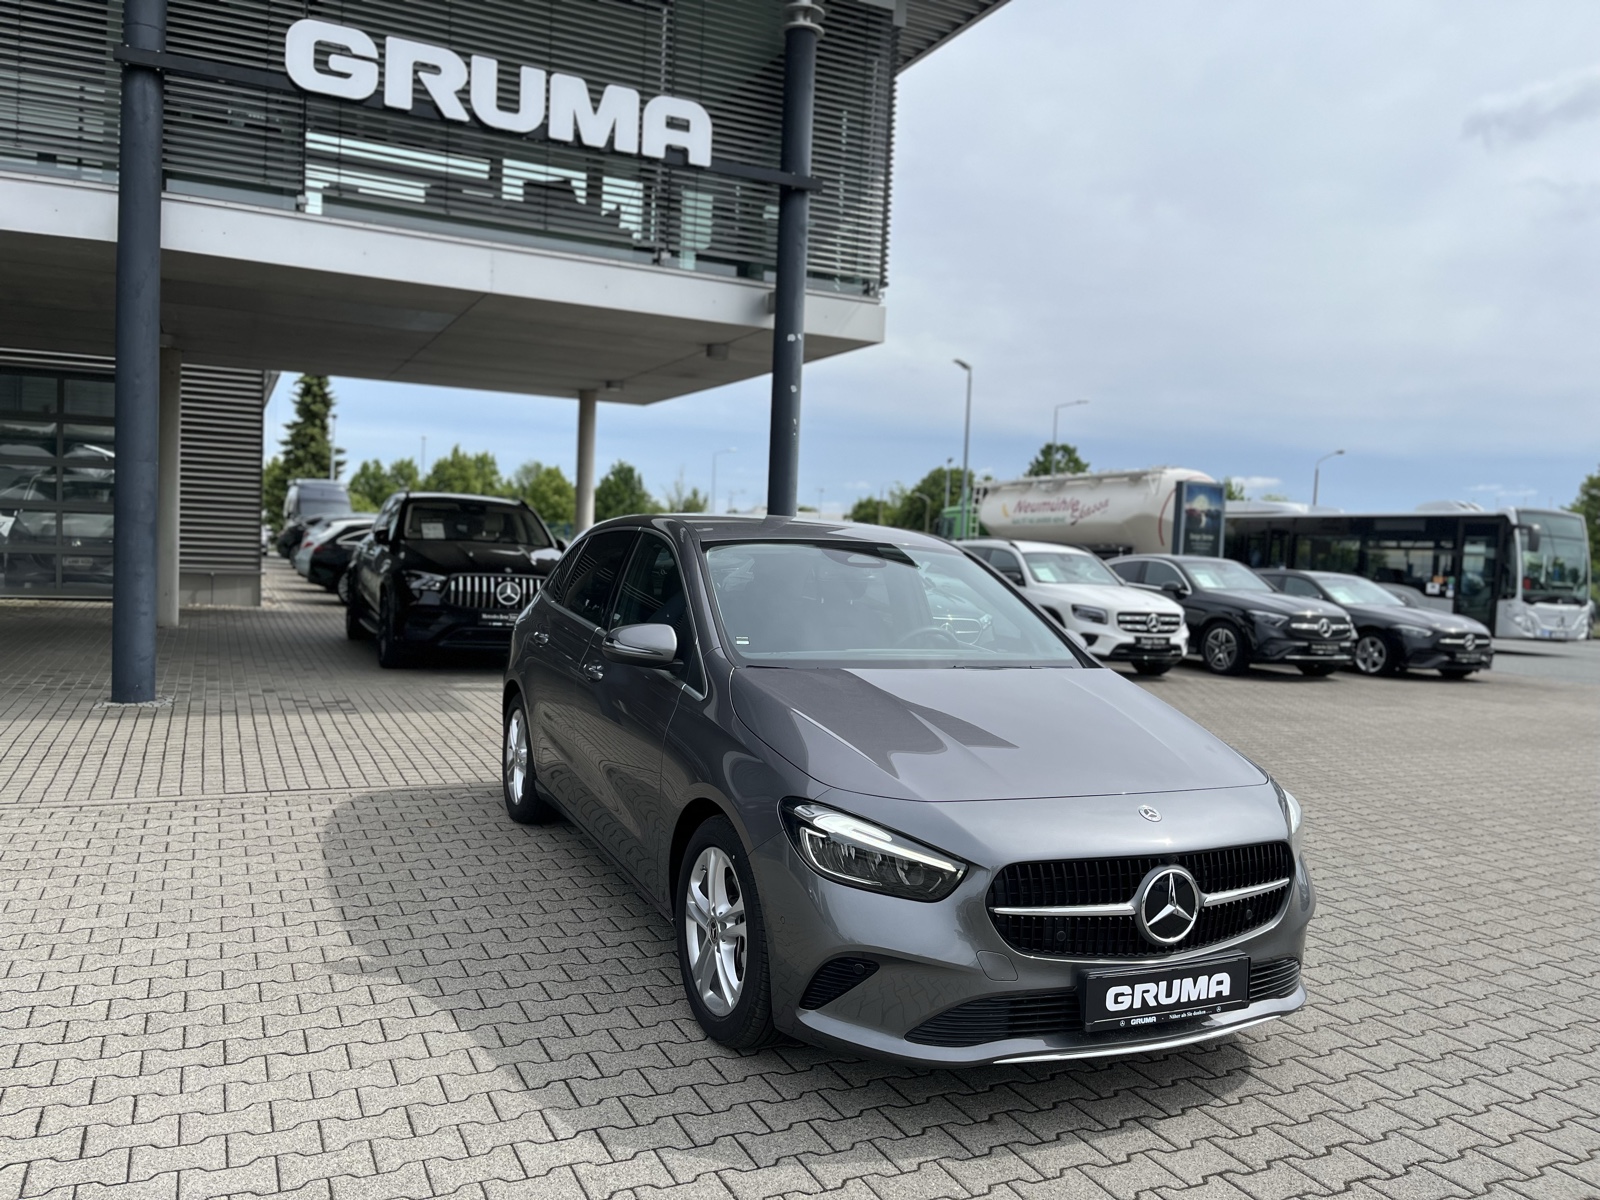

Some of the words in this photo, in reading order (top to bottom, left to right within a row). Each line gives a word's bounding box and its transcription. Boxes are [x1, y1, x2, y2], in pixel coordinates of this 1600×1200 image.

[285, 18, 712, 168] GRUMA
[1105, 972, 1231, 1012] GRUMA
[1130, 1016, 1157, 1026] GRUMA
